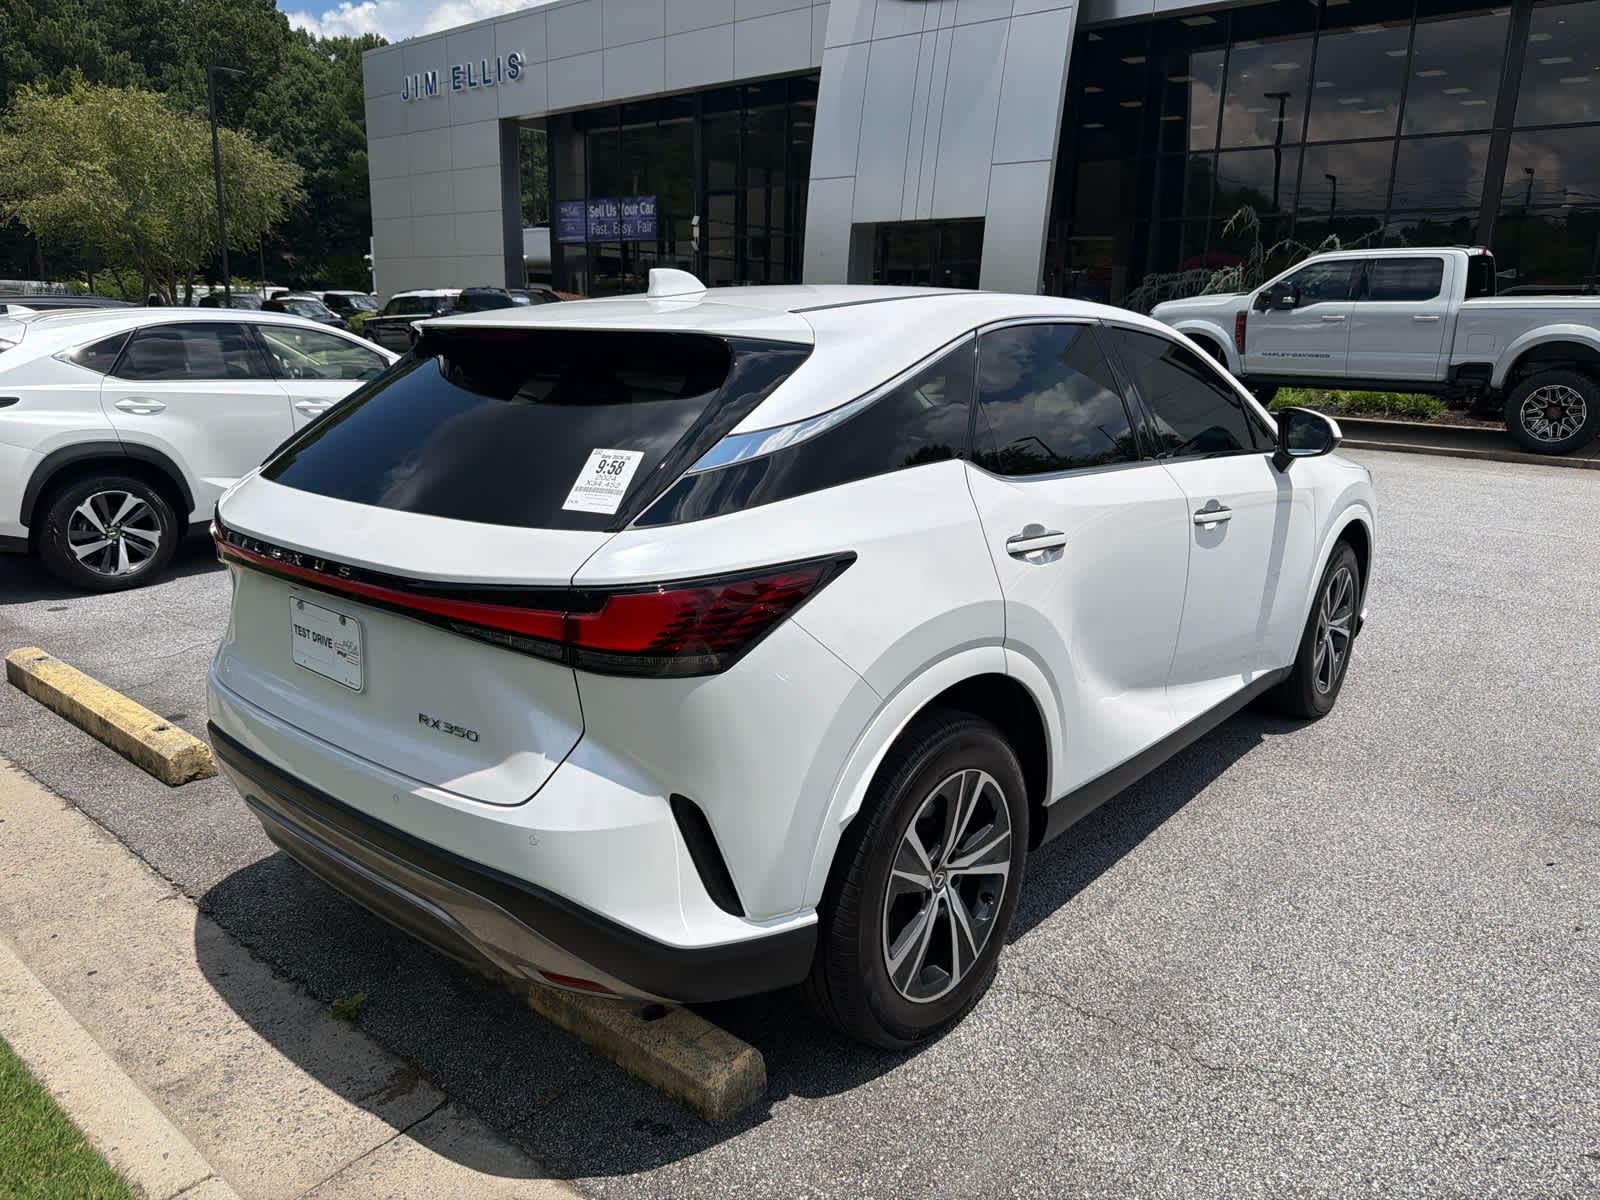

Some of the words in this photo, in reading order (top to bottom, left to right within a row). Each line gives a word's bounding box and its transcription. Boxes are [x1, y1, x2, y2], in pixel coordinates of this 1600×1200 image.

[401, 70, 439, 101] JIM
[451, 52, 521, 91] ELLIS
[588, 204, 605, 218] Sell
[606, 203, 617, 217] Us
[590, 222, 610, 236] Fast.
[595, 459, 625, 475] 9:58
[293, 623, 311, 640] TEST
[312, 631, 333, 649] DRIVE
